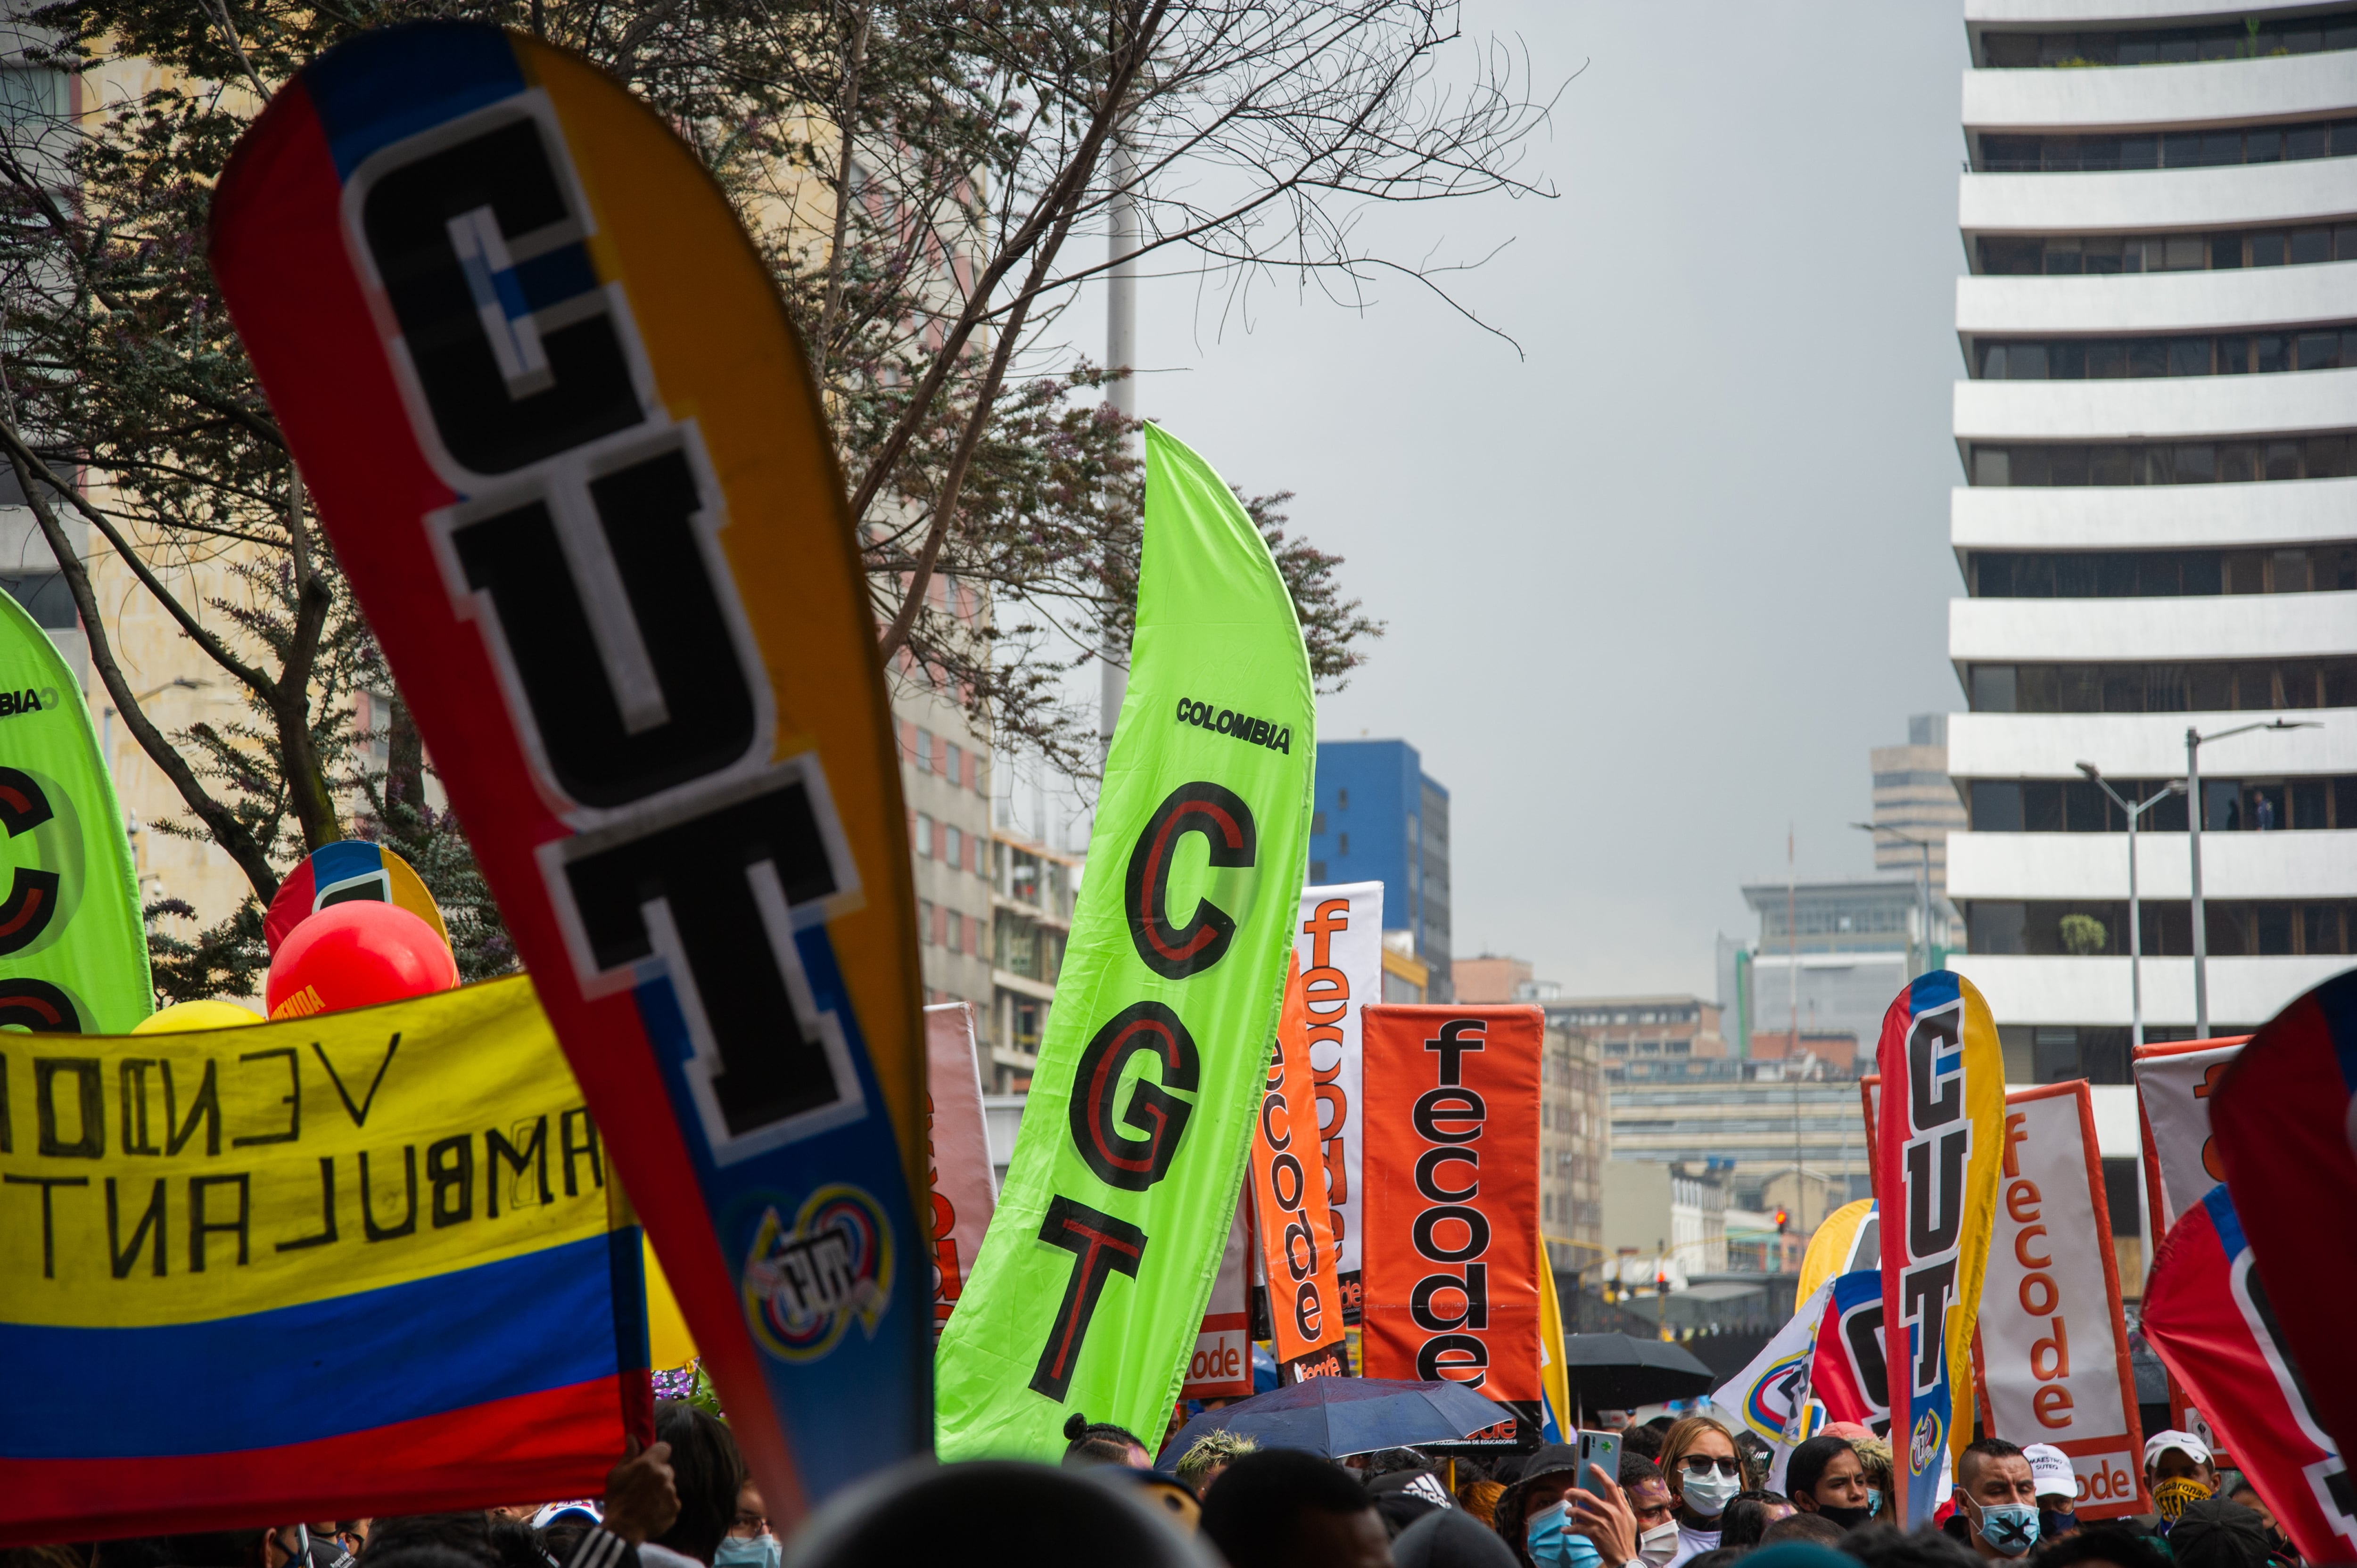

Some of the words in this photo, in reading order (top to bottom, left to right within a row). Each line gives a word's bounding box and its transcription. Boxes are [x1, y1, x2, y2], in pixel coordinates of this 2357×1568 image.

[339, 86, 866, 1168] CUT
[1176, 697, 1290, 755] COLOMBIA
[1028, 781, 1256, 1404] CGT
[1409, 1018, 1492, 1389] fecode
[1900, 997, 1973, 1397] CUT
